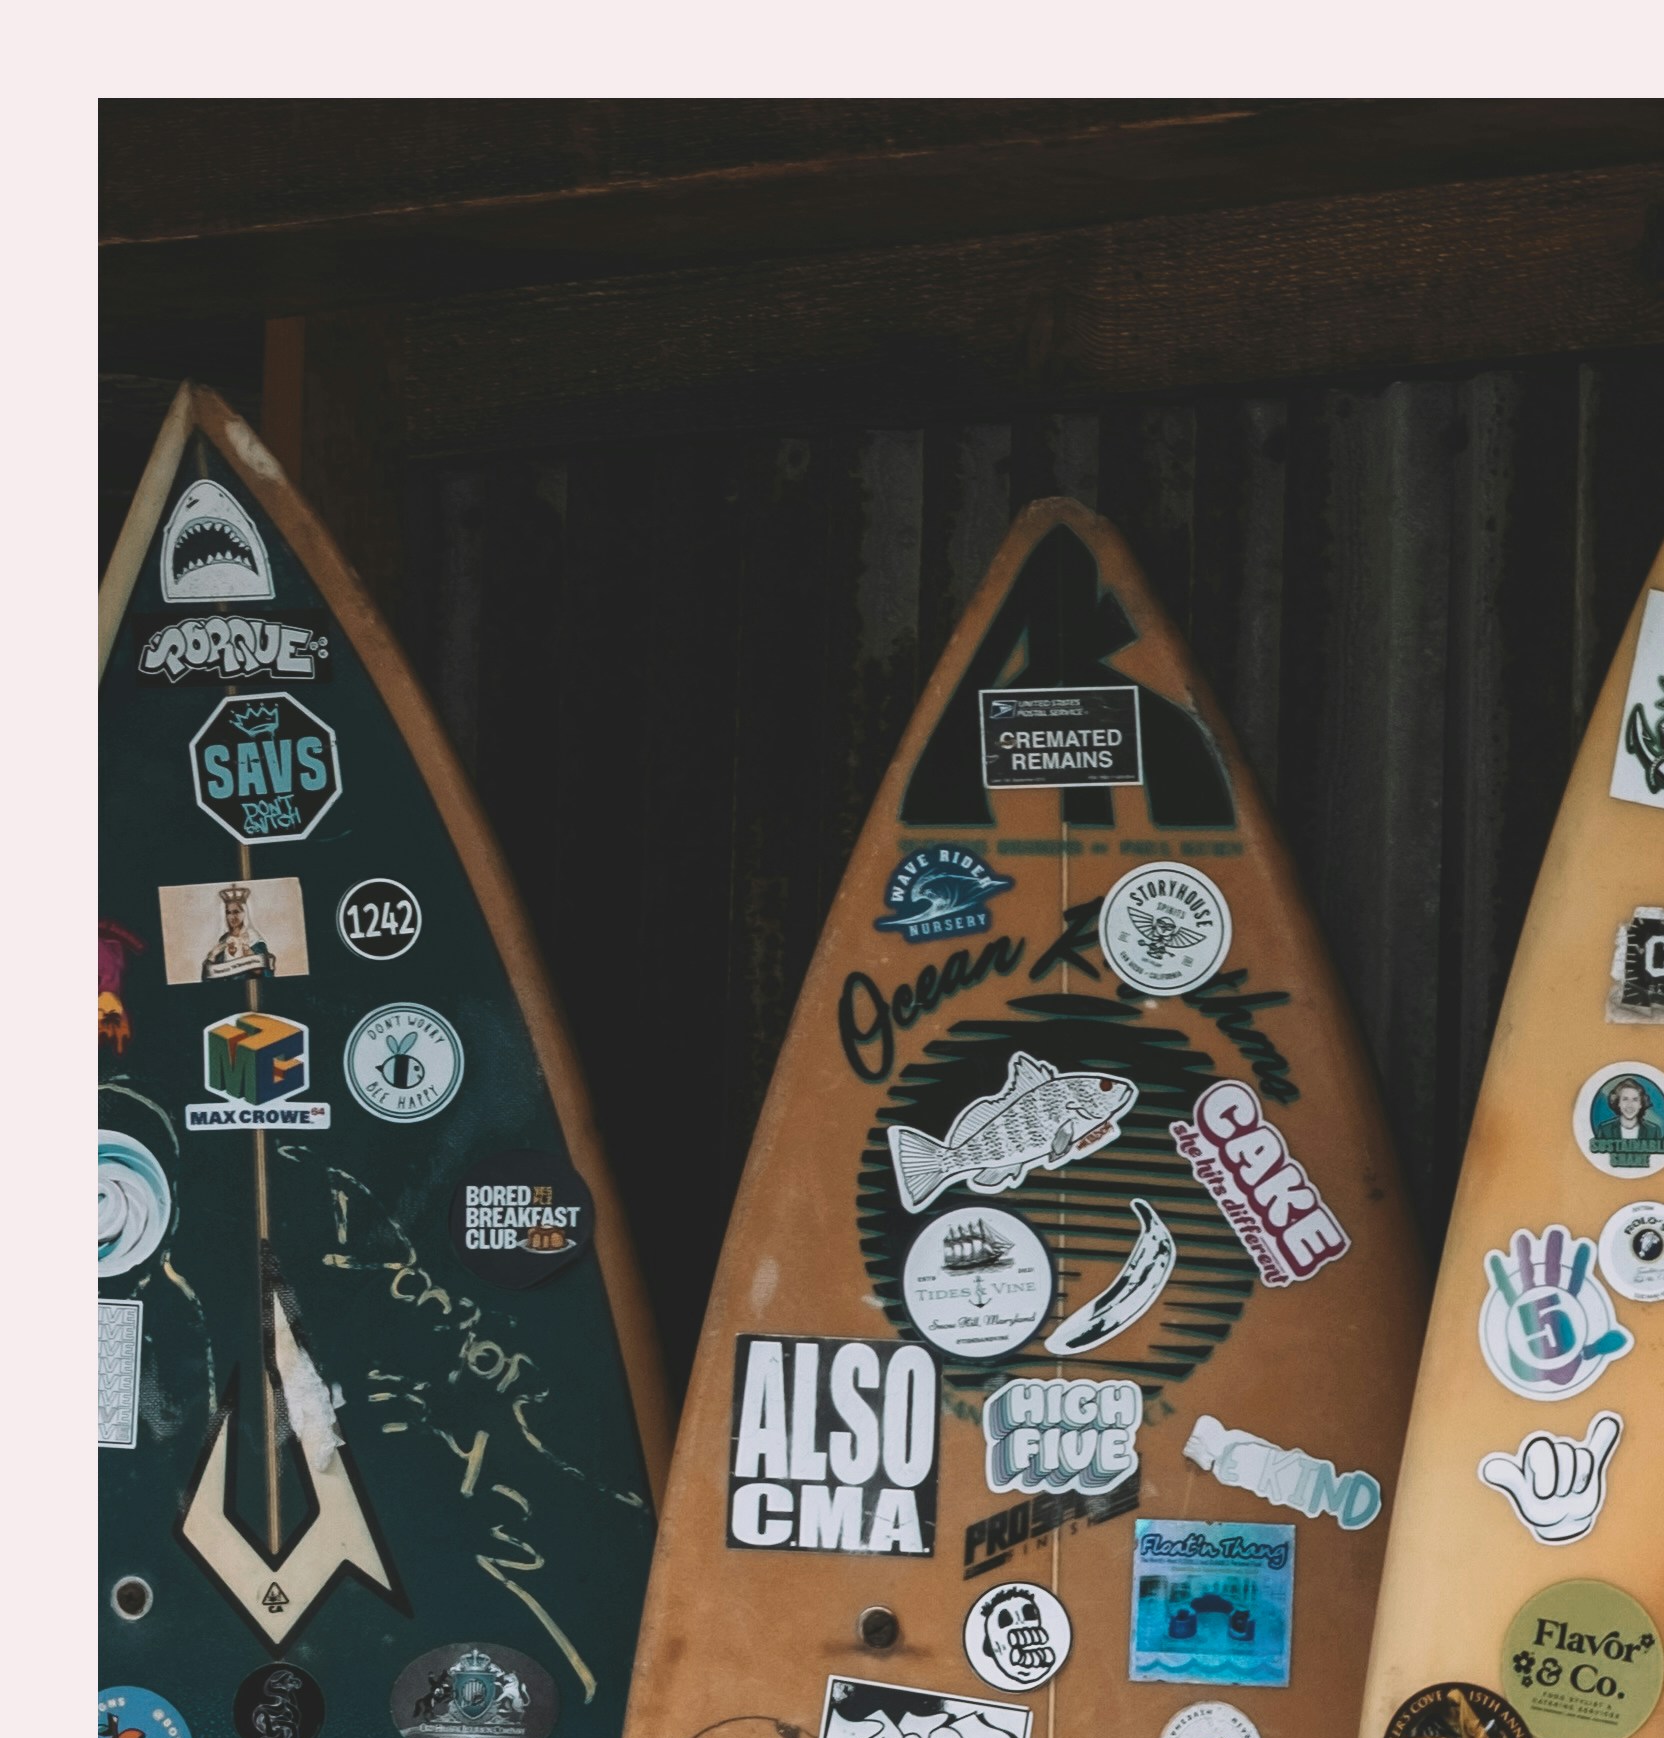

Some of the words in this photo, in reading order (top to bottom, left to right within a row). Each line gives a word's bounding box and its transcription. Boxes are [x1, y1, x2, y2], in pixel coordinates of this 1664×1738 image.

[1000, 729, 1122, 749] CREMATED
[204, 737, 327, 799] SAVS
[1012, 751, 1113, 770] REMAINS
[1130, 879, 1213, 928] STORYHOUSE
[347, 900, 415, 939] 1242
[909, 914, 986, 937] NURSERY
[367, 1015, 401, 1040] DON'T
[407, 1015, 445, 1045] WORRY
[365, 1082, 387, 1104] BEE
[397, 1084, 442, 1109] HAPPY
[190, 1109, 237, 1126] MAX
[239, 1108, 312, 1125] CROWE
[466, 1185, 531, 1207] BORED
[1200, 1089, 1345, 1275] CAKE
[1173, 1122, 1203, 1158] she
[1197, 1156, 1228, 1197] hits
[1217, 1197, 1290, 1285] different
[466, 1207, 581, 1229] BREAKFAST
[466, 1228, 519, 1249] CLUB
[734, 1341, 936, 1486] ALSO
[1007, 1386, 1137, 1427] HIGH
[1012, 1428, 1134, 1472] FIVE
[1532, 1619, 1641, 1663] Flavor
[1409, 1691, 1444, 1713] COVE
[1468, 1691, 1499, 1710] 15TH
